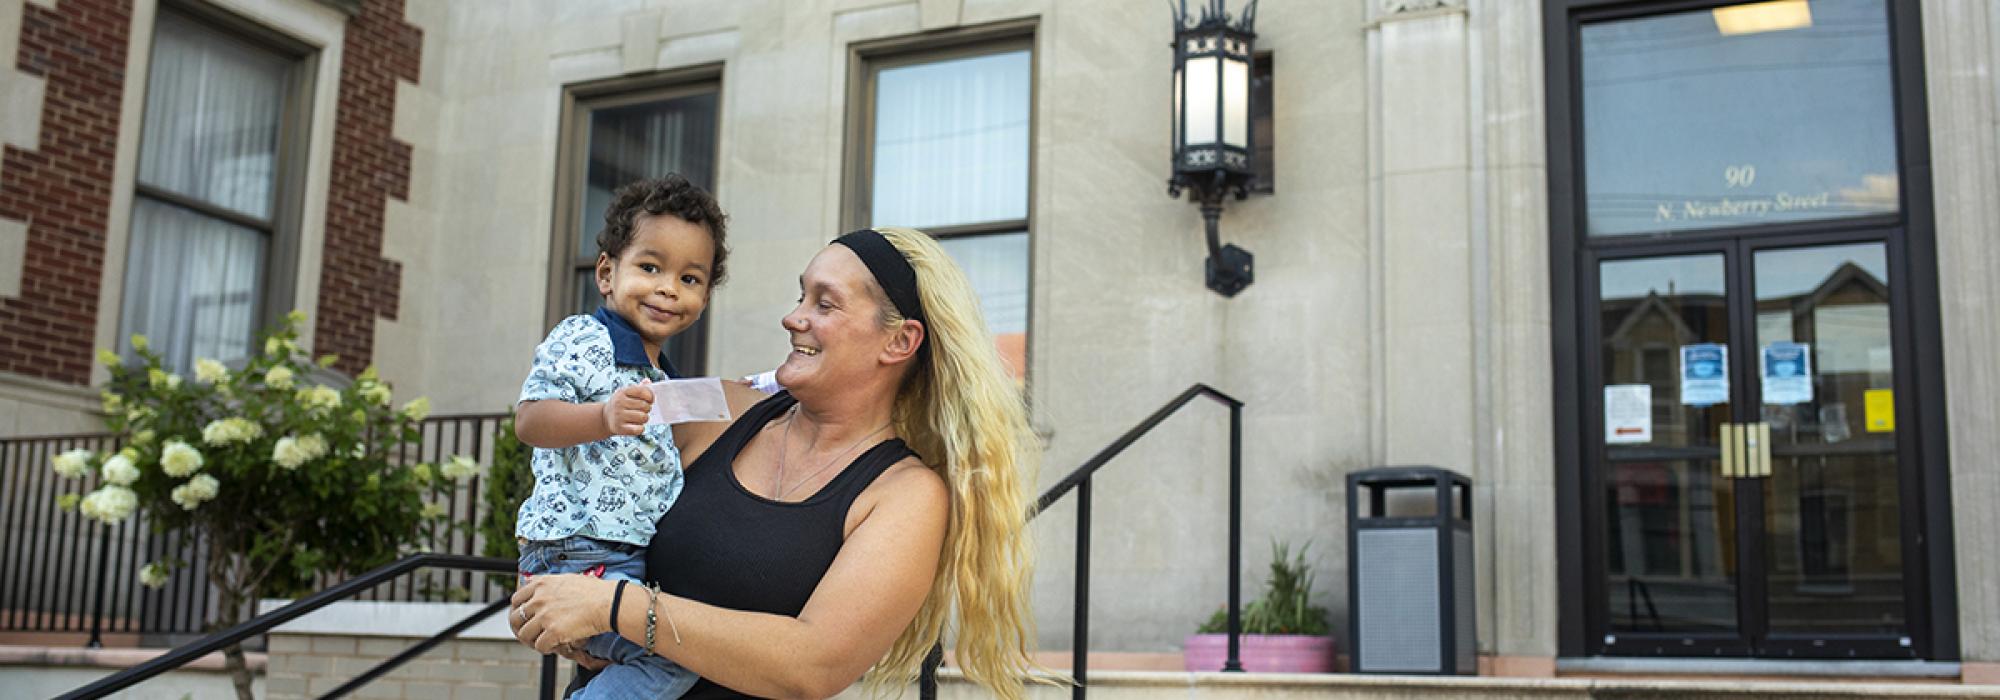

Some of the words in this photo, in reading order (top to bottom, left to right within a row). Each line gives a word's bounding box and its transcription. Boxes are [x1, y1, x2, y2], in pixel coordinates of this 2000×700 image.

[1725, 164, 1755, 187] 90
[1654, 202, 1676, 223] N.
[1685, 198, 1770, 218] Newberry
[1774, 192, 1829, 211] Street
